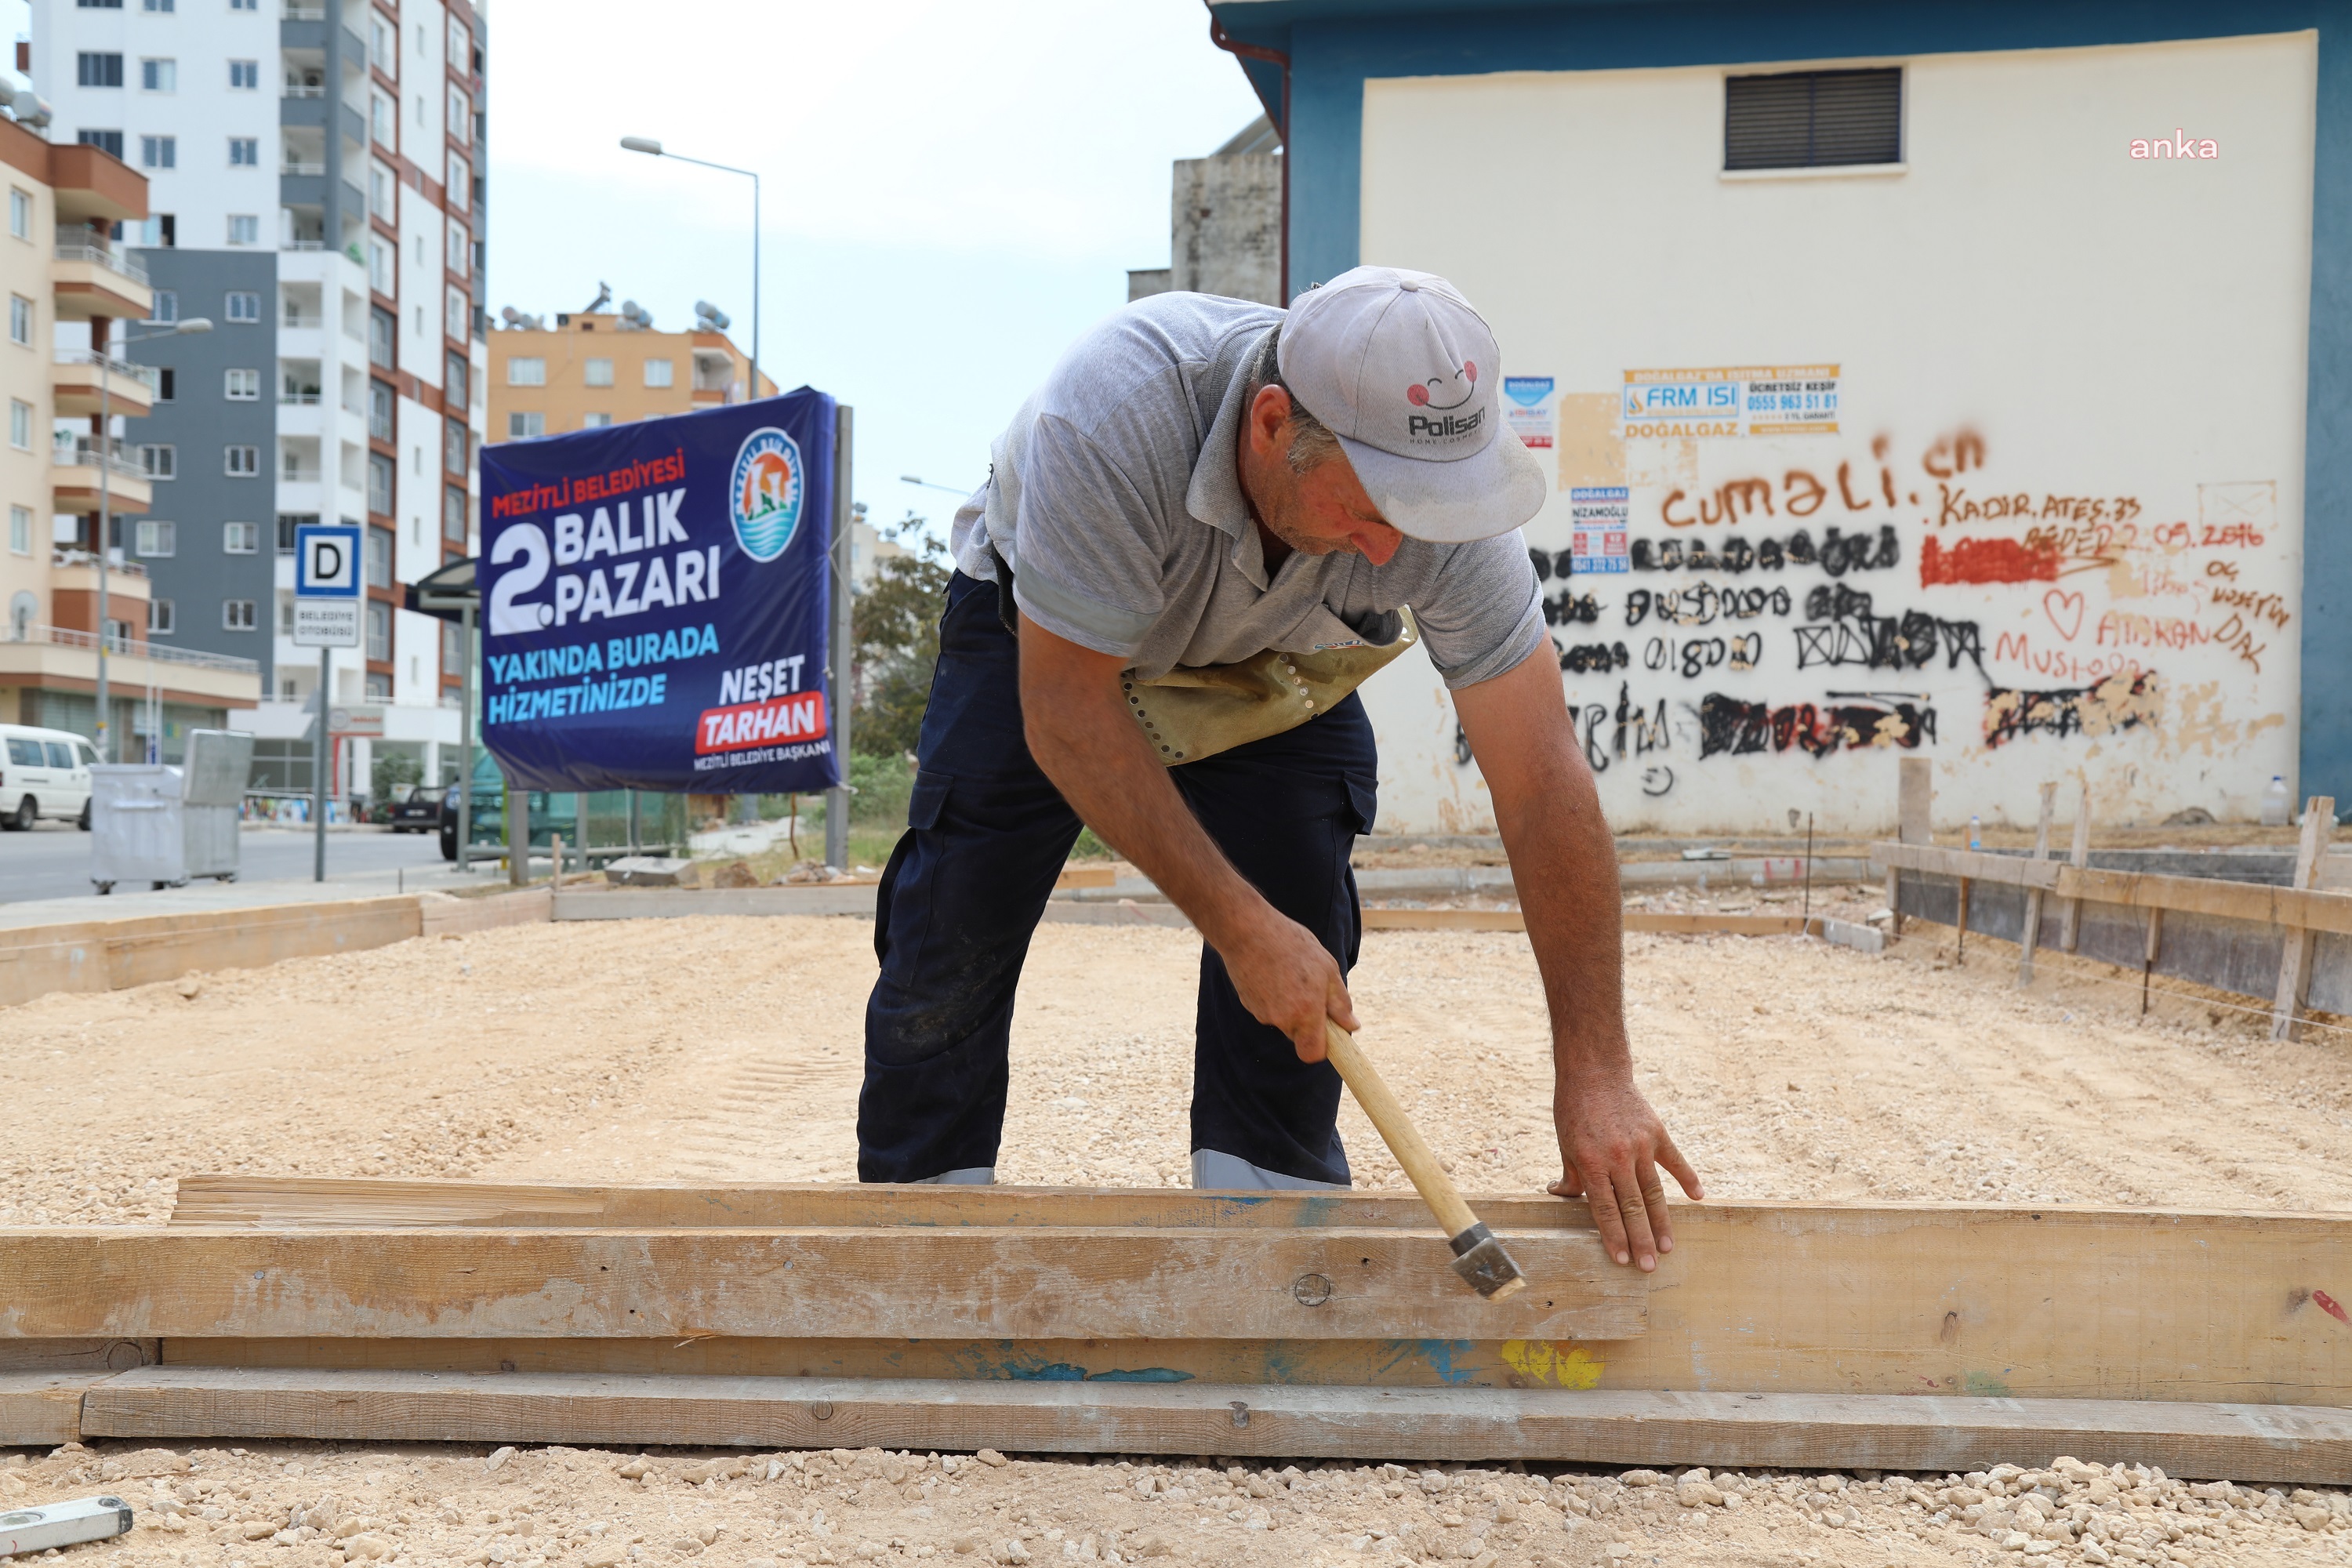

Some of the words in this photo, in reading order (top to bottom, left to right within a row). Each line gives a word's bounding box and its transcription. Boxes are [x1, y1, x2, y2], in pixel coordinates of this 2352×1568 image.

[1647, 387, 1697, 406] FRM
[1708, 386, 1736, 405] ISI
[1748, 394, 1776, 410] 0555
[1780, 394, 1802, 410] 963
[1806, 394, 1819, 409] 51
[1824, 393, 1837, 408] 81
[1749, 381, 1802, 393] ÜCRETSİZ
[1806, 380, 1836, 392] KEŞİF
[1408, 406, 1486, 437] Polisan
[1625, 419, 1738, 438] DOĞALGAZ
[492, 477, 570, 518] MEZİTLİ
[573, 447, 685, 503] BELEDİYESİ
[554, 487, 690, 565] BALIK
[1573, 506, 1628, 517] NİZAMOĞLU
[315, 543, 341, 579] D
[555, 545, 720, 626] PAZARI
[298, 624, 354, 636] OTOBÜSÜ
[299, 609, 354, 621] BELEDİYE
[488, 642, 603, 684] YAKINDA
[608, 623, 720, 670] BURADA
[719, 654, 805, 705] NEŞET
[488, 672, 667, 725] HİZMETİNİZDE
[705, 700, 816, 747] TARHAN
[694, 751, 729, 771] MEZİTLİ
[730, 747, 775, 767] BELEDİYE
[776, 740, 831, 762] BAŞKANI
